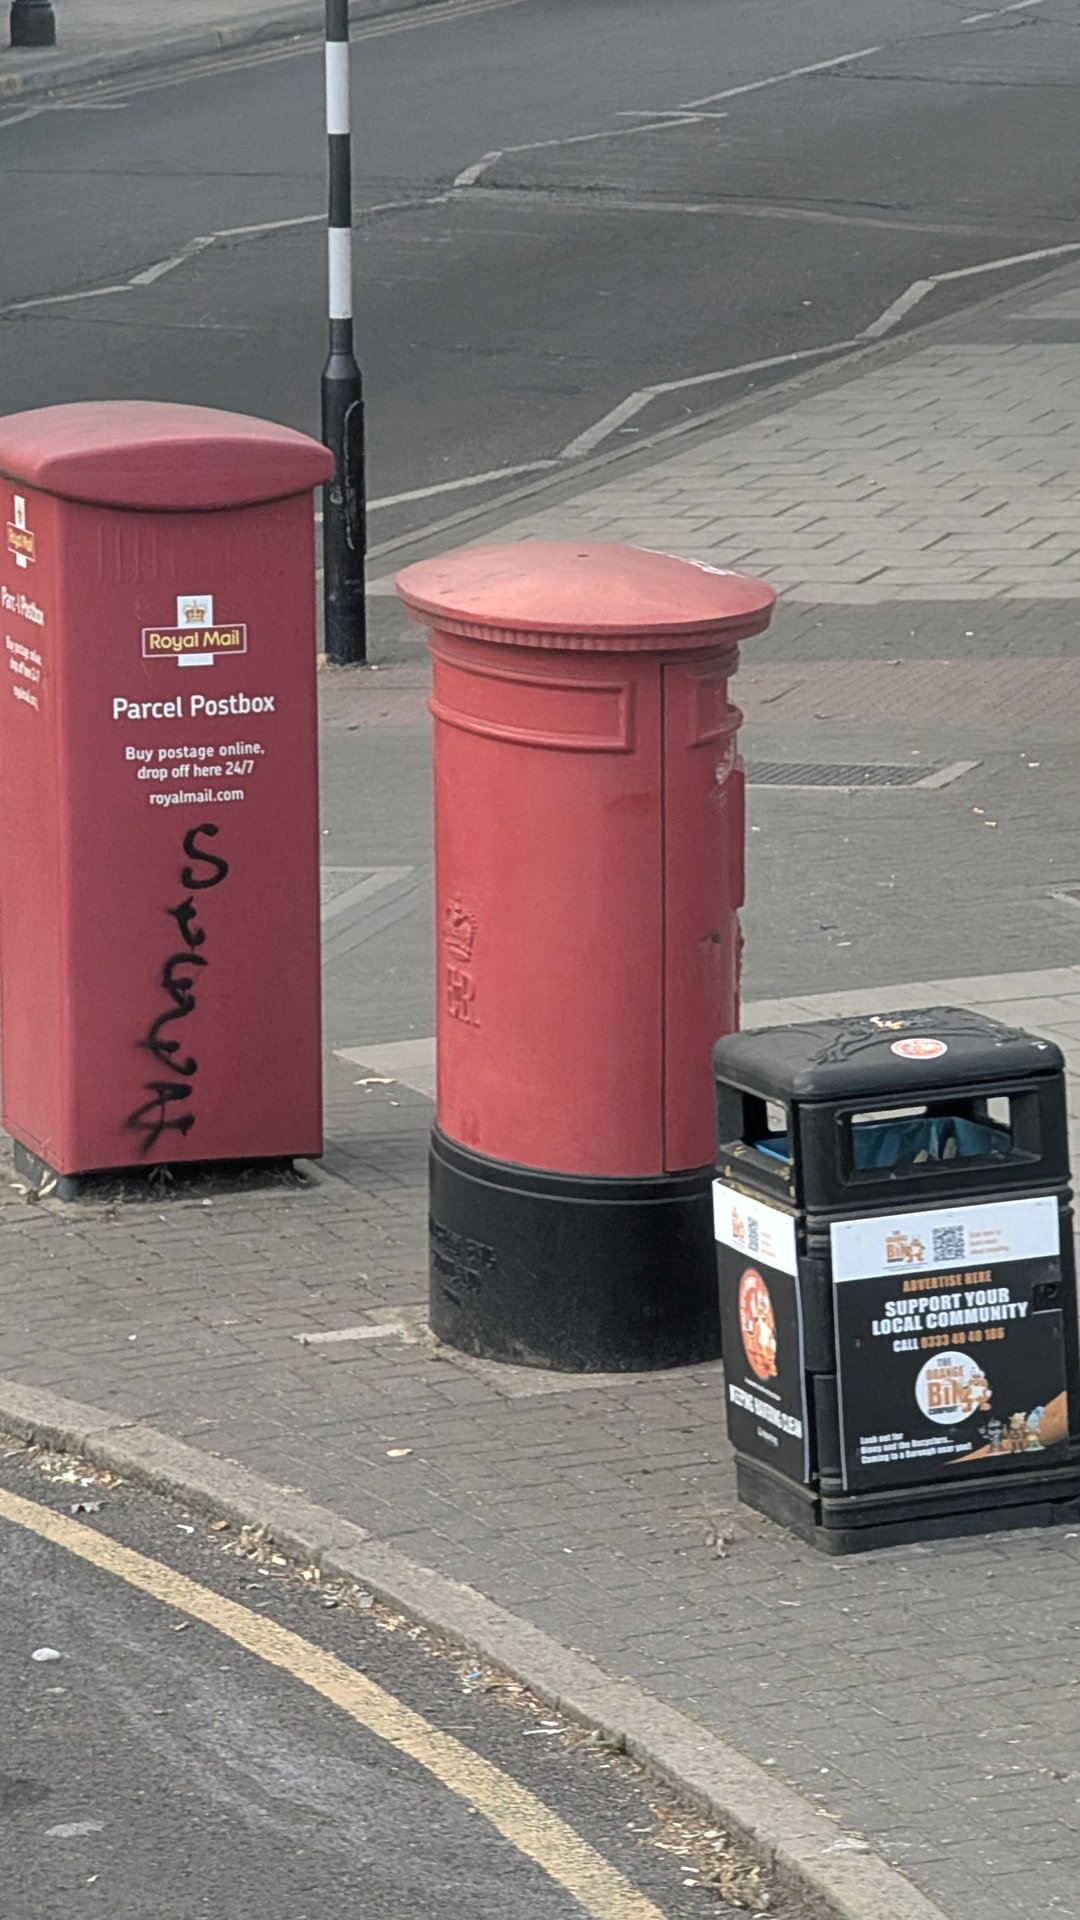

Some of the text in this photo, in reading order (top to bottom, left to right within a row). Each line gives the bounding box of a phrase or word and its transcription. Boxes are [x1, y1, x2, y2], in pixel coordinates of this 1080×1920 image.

[150, 630, 240, 651] Royal Mail
[113, 693, 275, 720] Parcel Postbox
[125, 746, 153, 762] Buy
[158, 746, 214, 762] postage
[137, 760, 254, 781] drop off here 24/7
[150, 789, 244, 807] royalmail.com
[903, 1270, 992, 1292] ADVERTISE HERE
[884, 1287, 1010, 1317] SUPPORT YOUR
[872, 1301, 1029, 1336] LOCAL COMMUNITY
[892, 1338, 919, 1352] CALL
